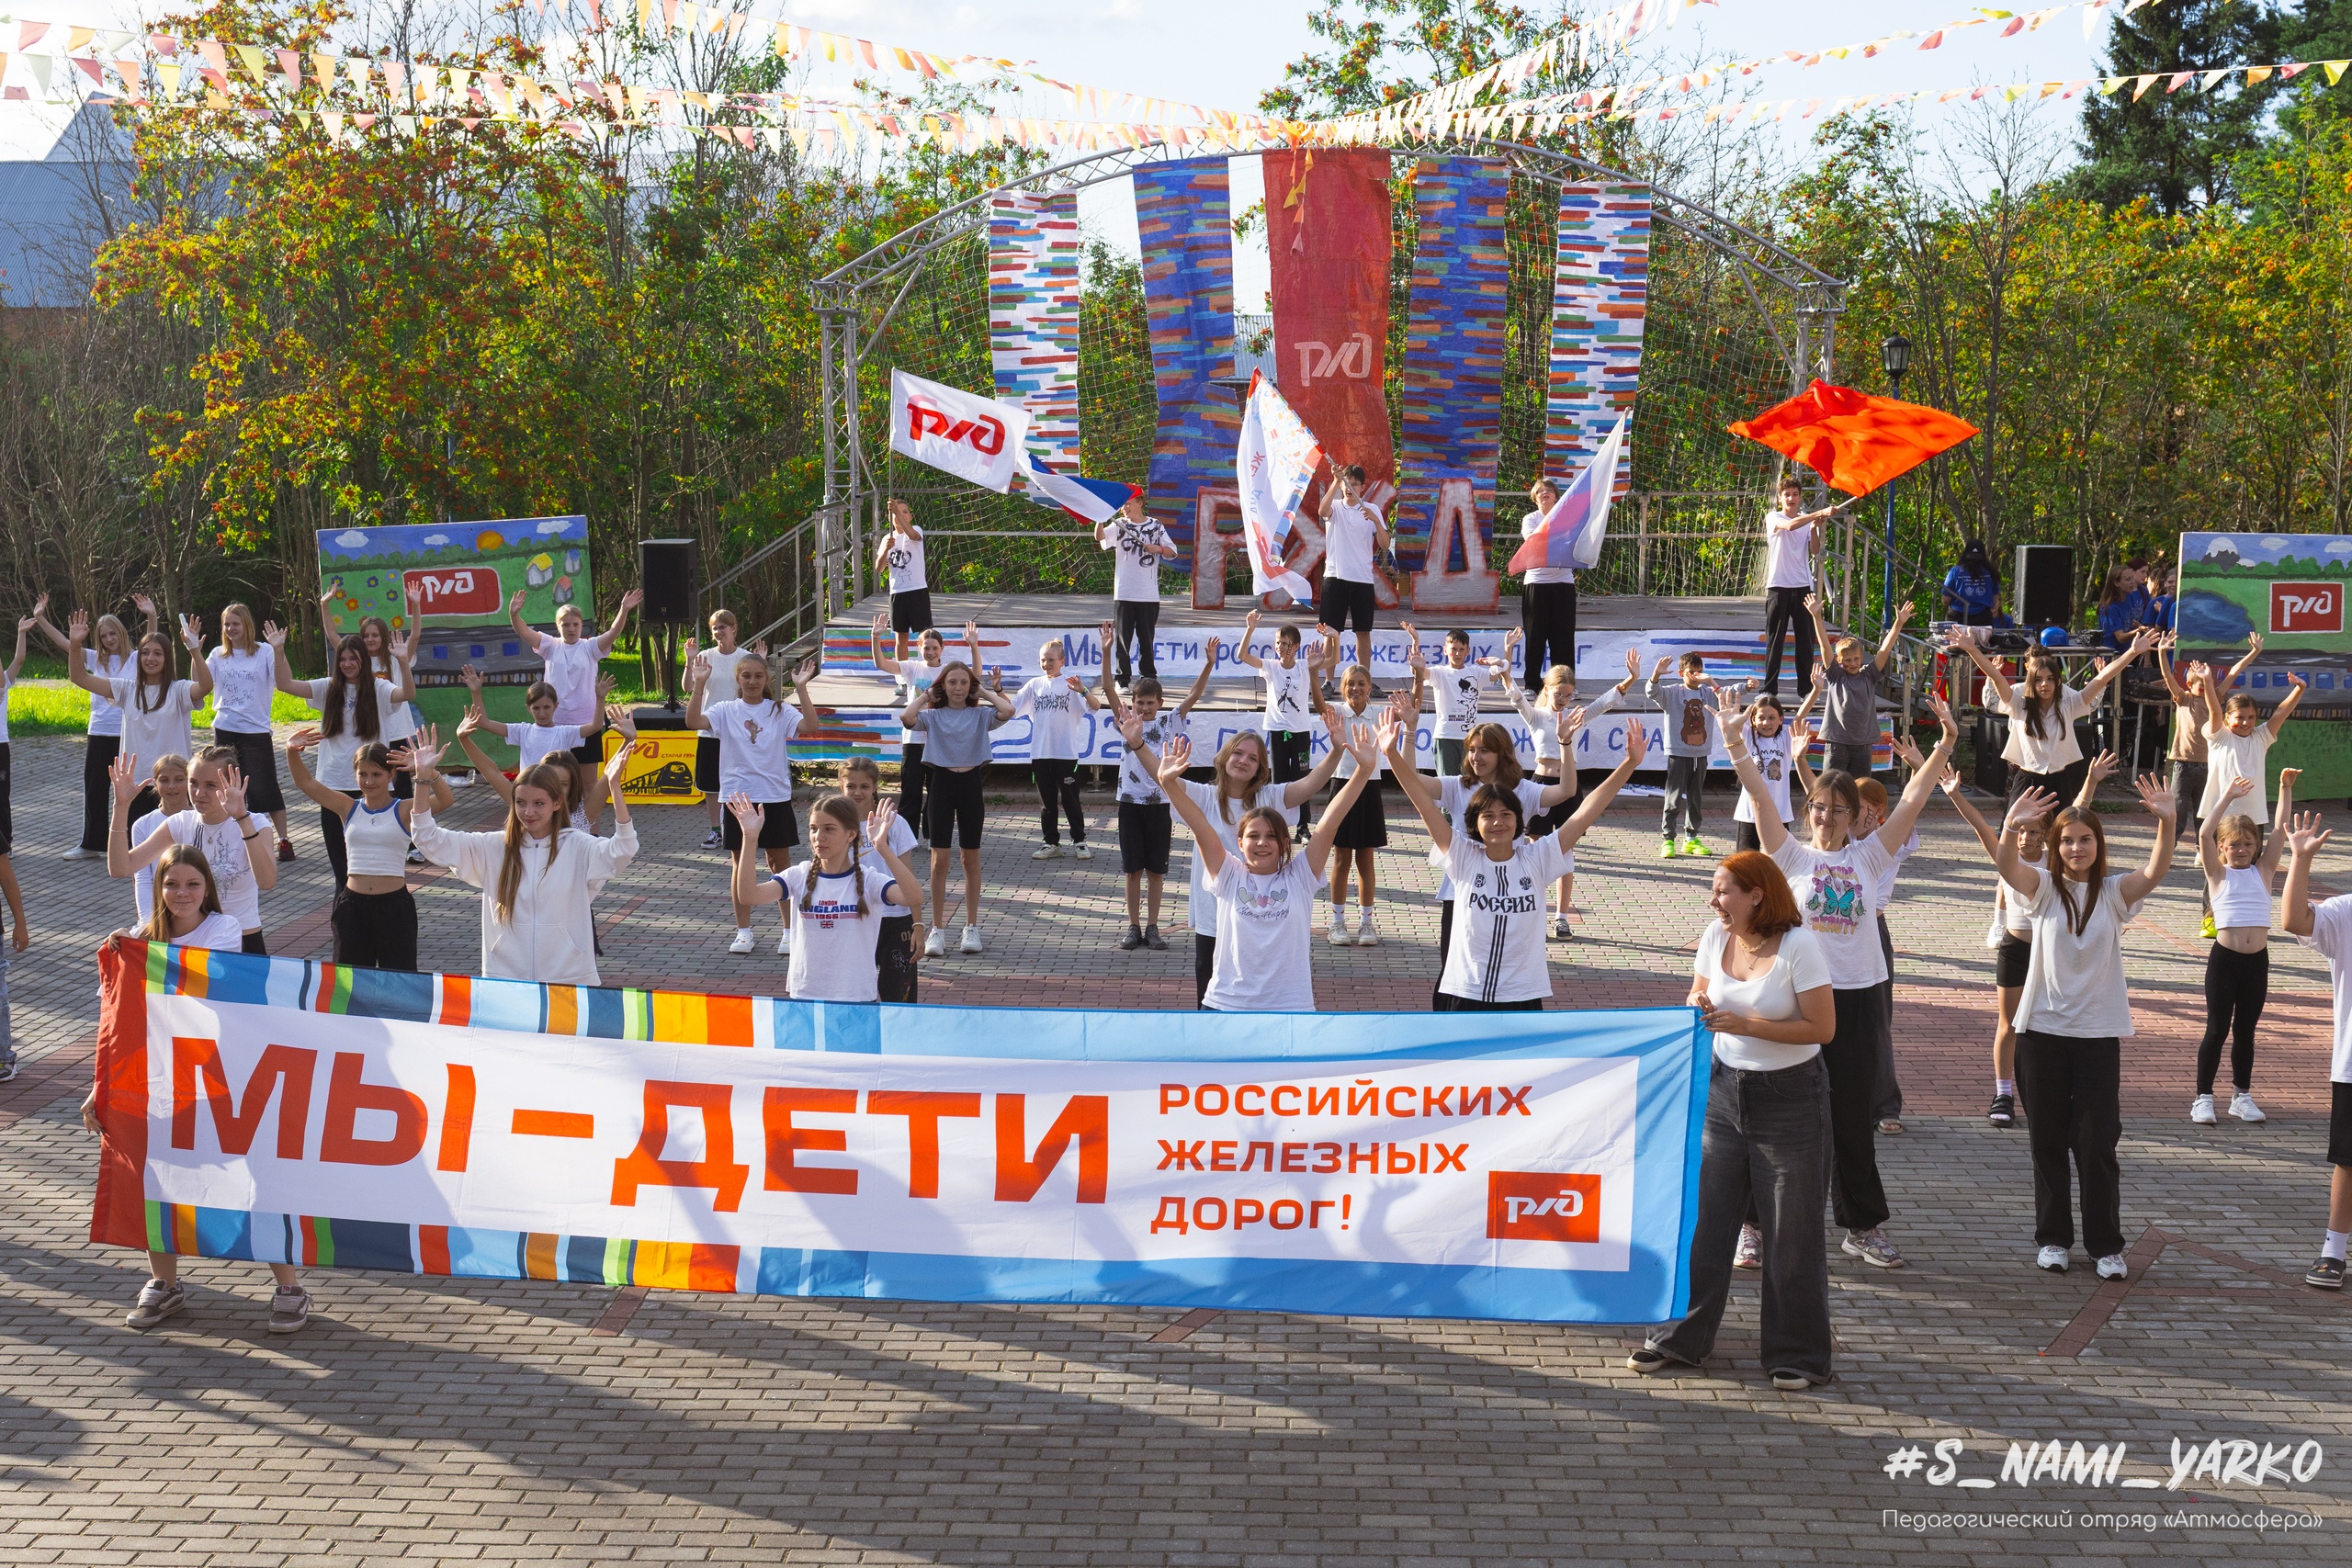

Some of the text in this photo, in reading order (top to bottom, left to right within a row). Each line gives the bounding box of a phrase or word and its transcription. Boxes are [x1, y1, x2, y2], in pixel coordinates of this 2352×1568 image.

[1469, 892, 1536, 914] РОССИЯ
[1159, 1079, 1532, 1118] РОССИЙСКИХ
[1158, 1140, 1469, 1175] ЖЕЛЕЗНЫХ
[1150, 1194, 1351, 1235] ДОРОГ!
